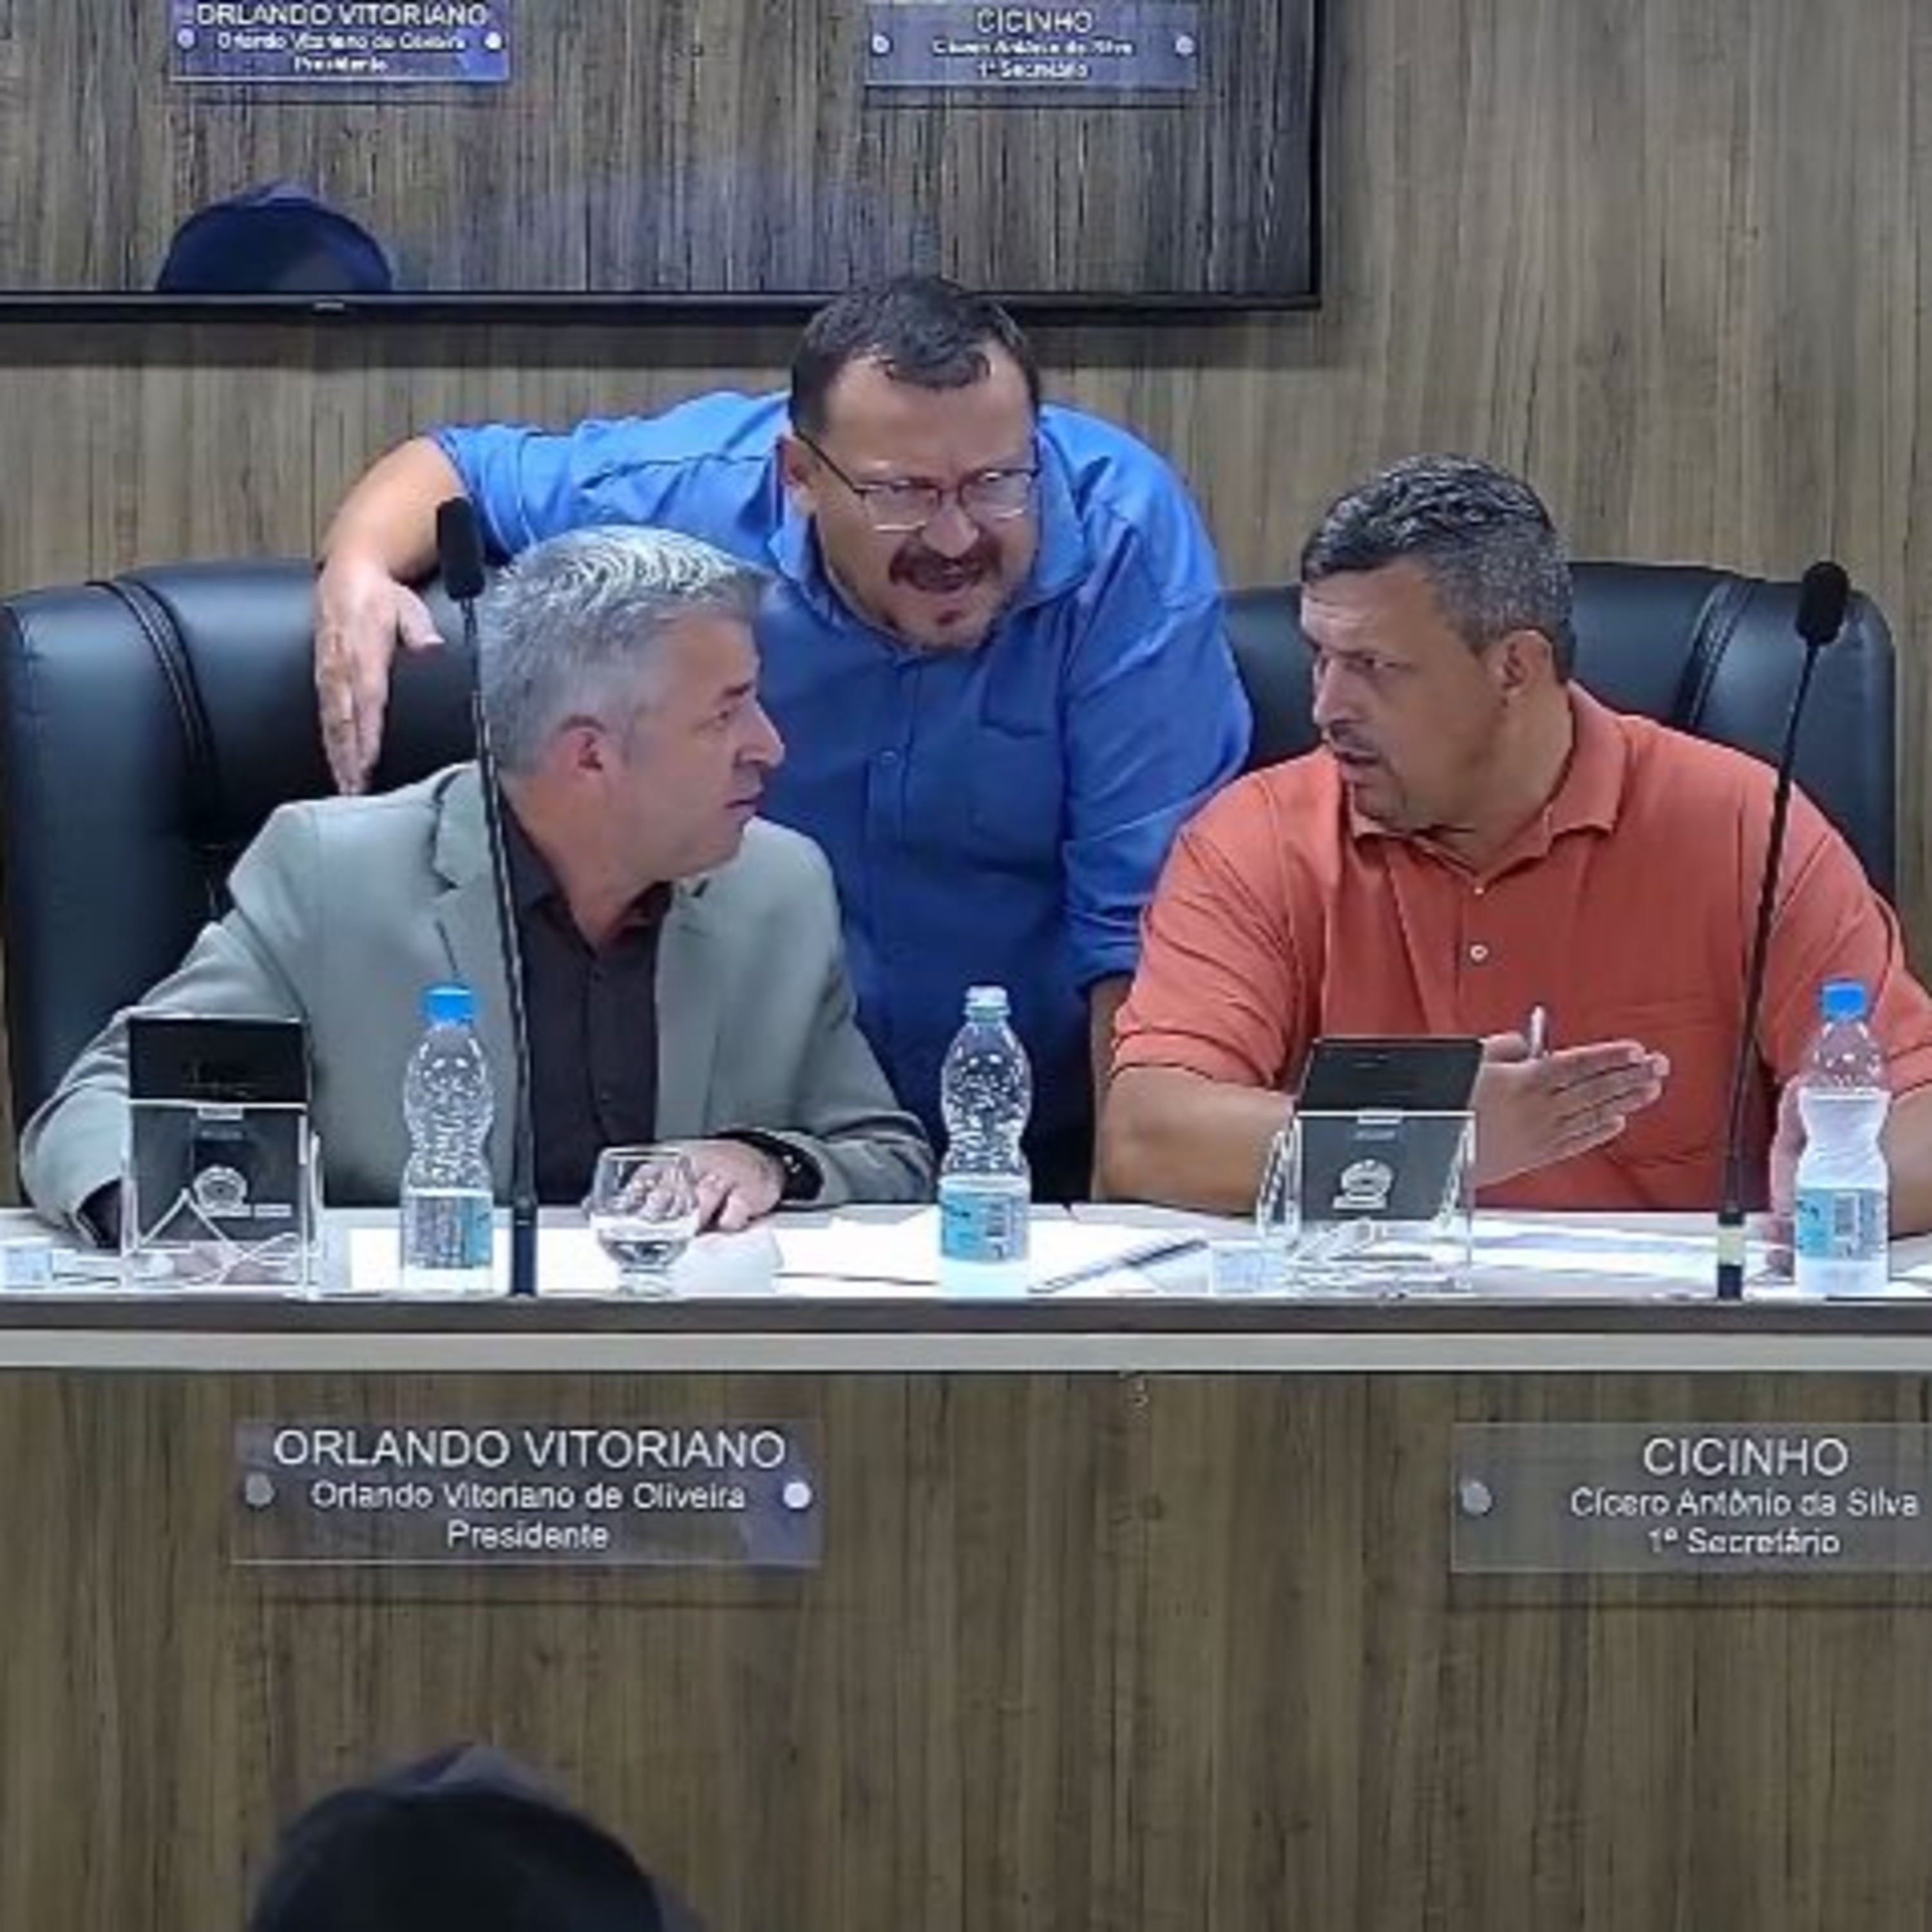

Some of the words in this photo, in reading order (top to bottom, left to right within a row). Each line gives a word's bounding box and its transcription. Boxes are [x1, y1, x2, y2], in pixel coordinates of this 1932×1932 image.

[197, 3, 331, 25] ORLANDO
[337, 3, 488, 25] VITORIANO
[977, 8, 1094, 33] CICINHO
[274, 1430, 511, 1468] ORLANDO
[523, 1430, 786, 1468] VITORIANO
[1643, 1437, 1850, 1477] CICINHO
[310, 1480, 433, 1510] Orlando
[443, 1480, 577, 1510] Vitoriano
[584, 1480, 623, 1510] de
[632, 1480, 746, 1510] Oliveira
[1570, 1486, 1671, 1517] Cícero
[1676, 1486, 1792, 1517] Antônio
[1799, 1486, 1837, 1517] da
[1846, 1486, 1920, 1517] Silva
[447, 1519, 609, 1549] Presidente
[1685, 1525, 1841, 1555] Secretário
